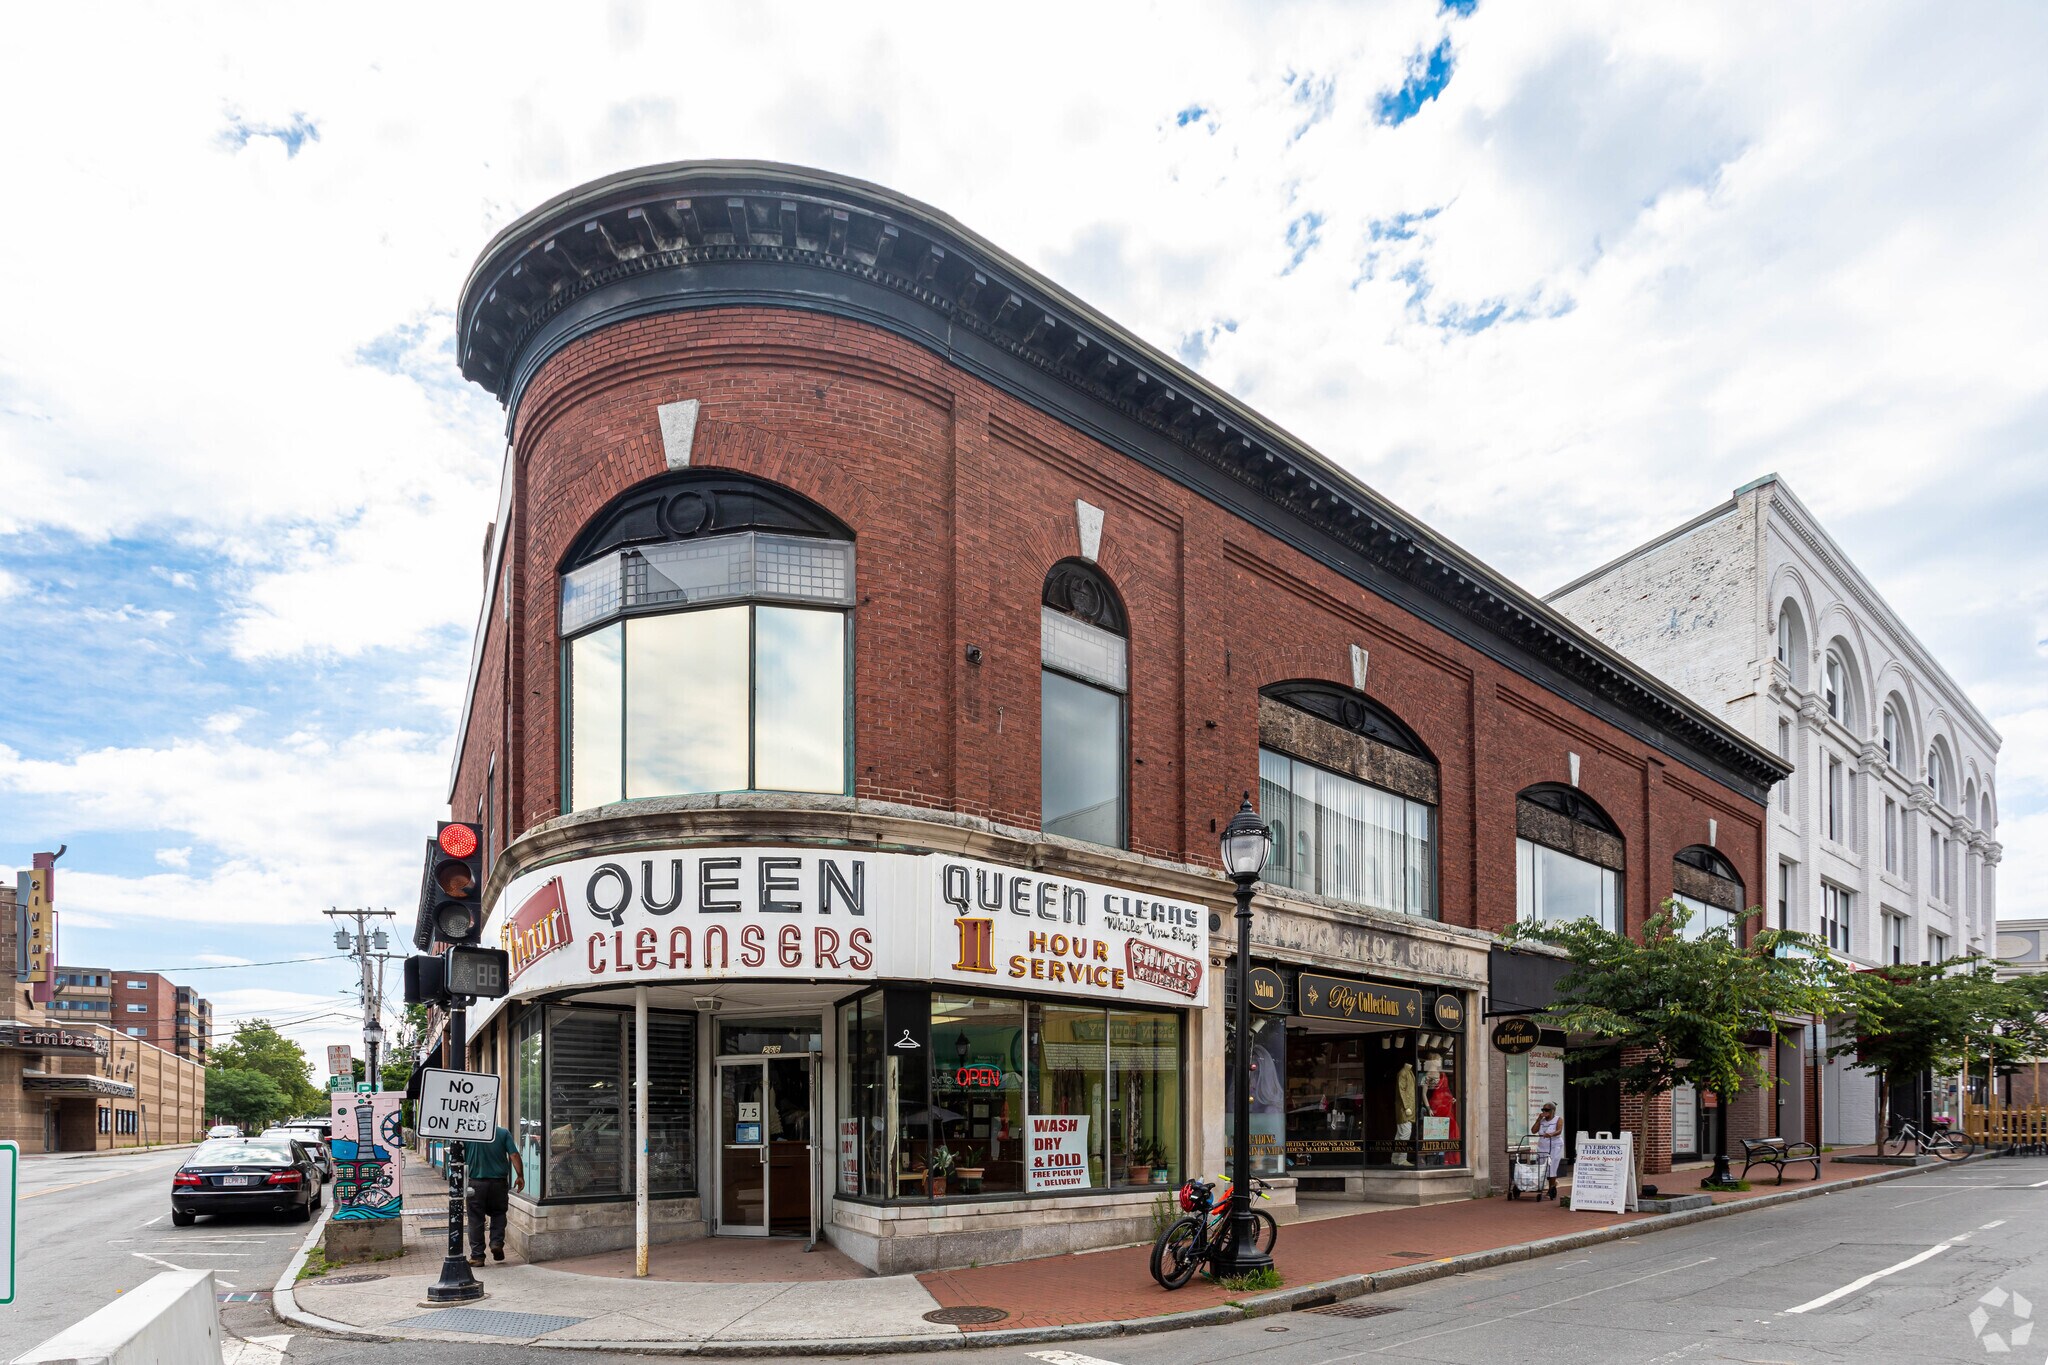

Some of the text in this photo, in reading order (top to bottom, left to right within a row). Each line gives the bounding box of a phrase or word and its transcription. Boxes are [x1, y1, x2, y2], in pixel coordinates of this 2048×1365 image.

[586, 856, 865, 928] QUEEN
[942, 863, 1088, 926] QUEEN
[1103, 893, 1199, 928] CLEANS
[30, 879, 41, 970] CINEMA
[1104, 916, 1200, 950] While You Shop
[588, 924, 873, 975] CLEANSERS
[952, 917, 997, 975] 1
[1028, 930, 1109, 962] HOUR
[1132, 943, 1198, 980] SHIRTS
[1008, 955, 1125, 990] SERVICE
[1254, 979, 1274, 998] Salon
[1329, 984, 1400, 1017] Raj Collections
[1439, 1005, 1459, 1022] Clothing
[1505, 1022, 1524, 1033] Raj
[1497, 1034, 1533, 1045] Collections
[331, 1076, 337, 1085] 15
[956, 1066, 1000, 1087] OPEN
[449, 1080, 474, 1094] NO
[440, 1098, 480, 1113] TURN
[428, 1116, 487, 1132] ON RED
[1034, 1119, 1078, 1132] WASH
[1034, 1137, 1062, 1151] DRY
[1422, 1141, 1460, 1151] ALTERATIONS
[1034, 1153, 1081, 1167] & FOLD
[1044, 1178, 1081, 1187] DELIVERY
